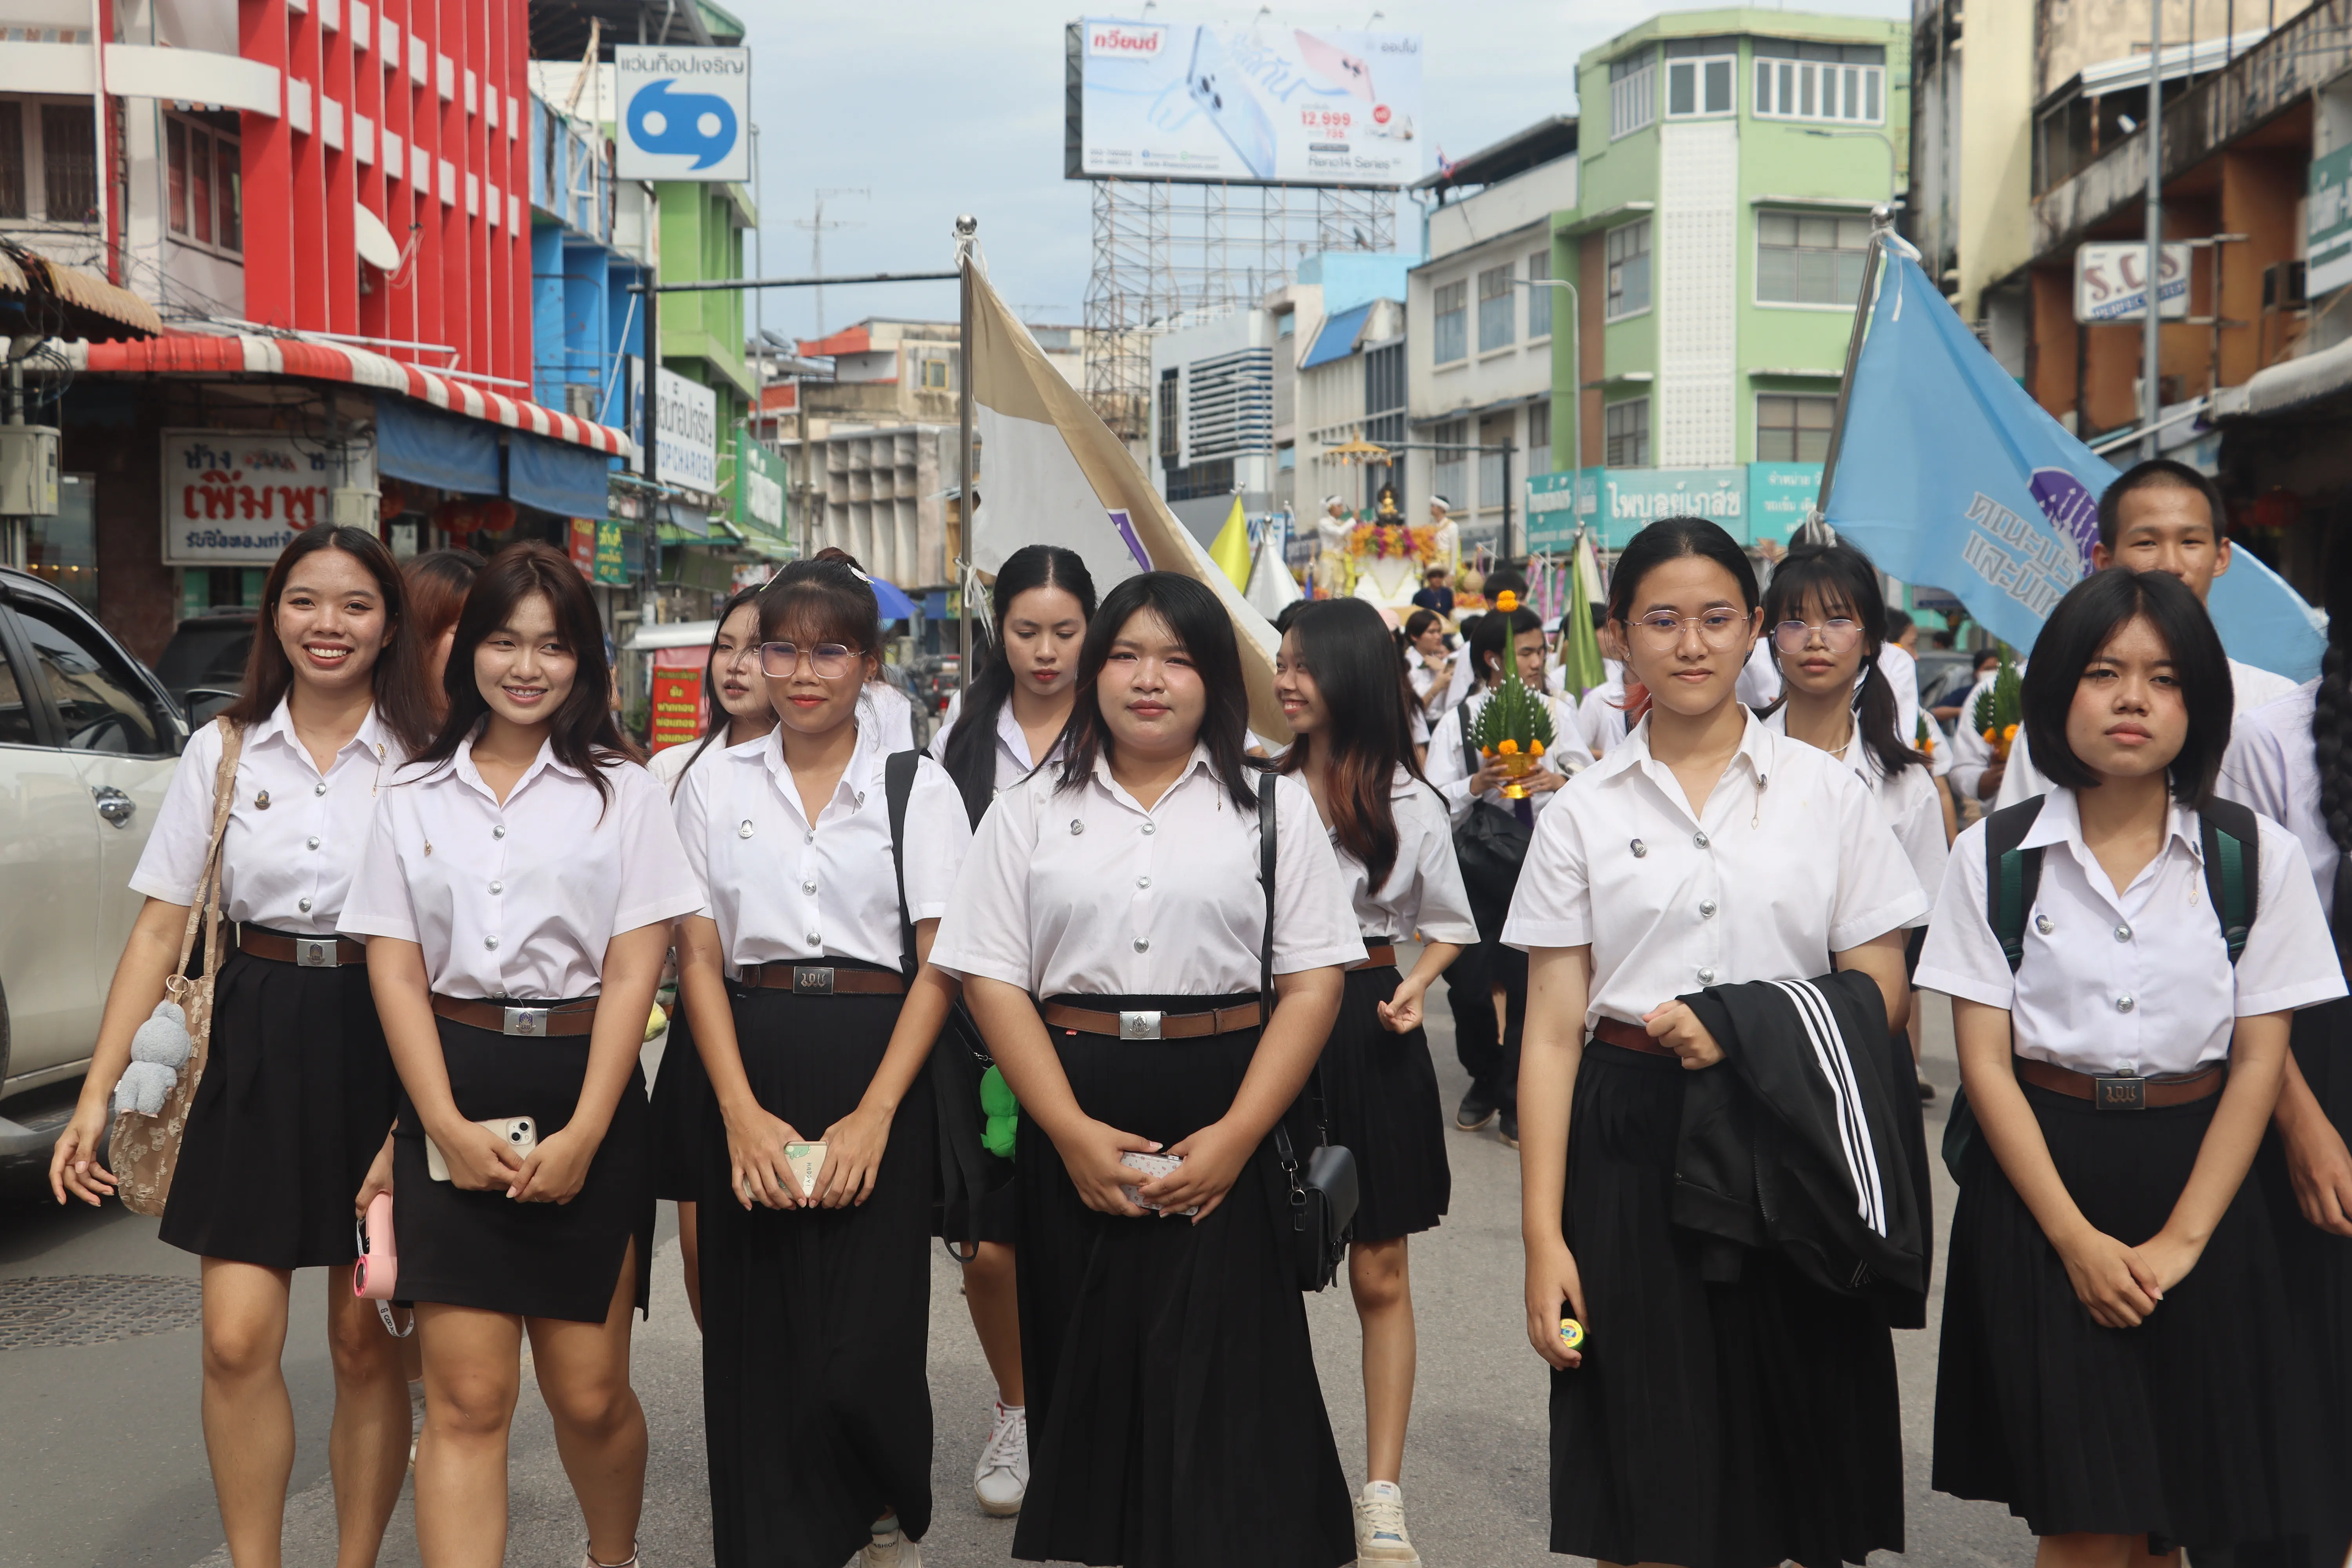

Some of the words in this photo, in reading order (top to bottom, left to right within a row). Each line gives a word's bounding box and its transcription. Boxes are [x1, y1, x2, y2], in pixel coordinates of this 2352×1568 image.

[621, 52, 744, 76] แว่นท็อปเจริญ
